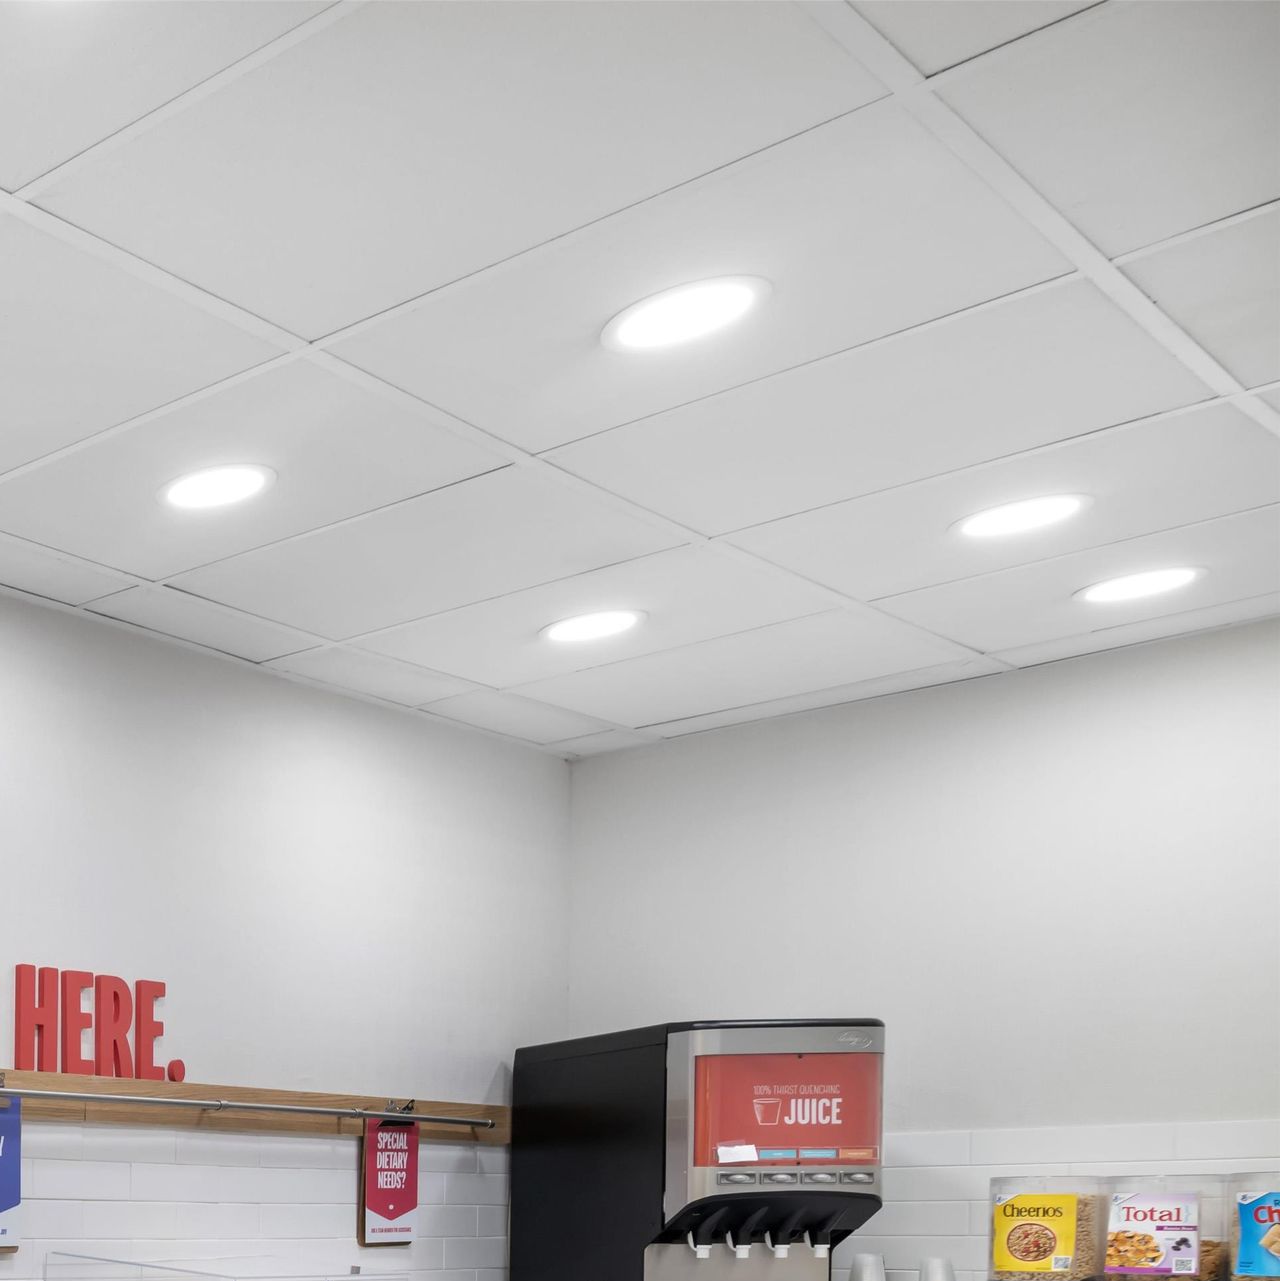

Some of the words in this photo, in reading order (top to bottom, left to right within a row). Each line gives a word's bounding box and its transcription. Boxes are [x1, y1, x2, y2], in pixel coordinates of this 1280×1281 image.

[15, 964, 185, 1082] HERE.
[784, 1098, 843, 1125] JUICE
[377, 1131, 408, 1150] SPECIAL
[376, 1151, 408, 1169] DIETARY
[377, 1171, 406, 1189] NEEDS?
[1002, 1203, 1063, 1218] Cheerios
[1122, 1206, 1183, 1222] Total
